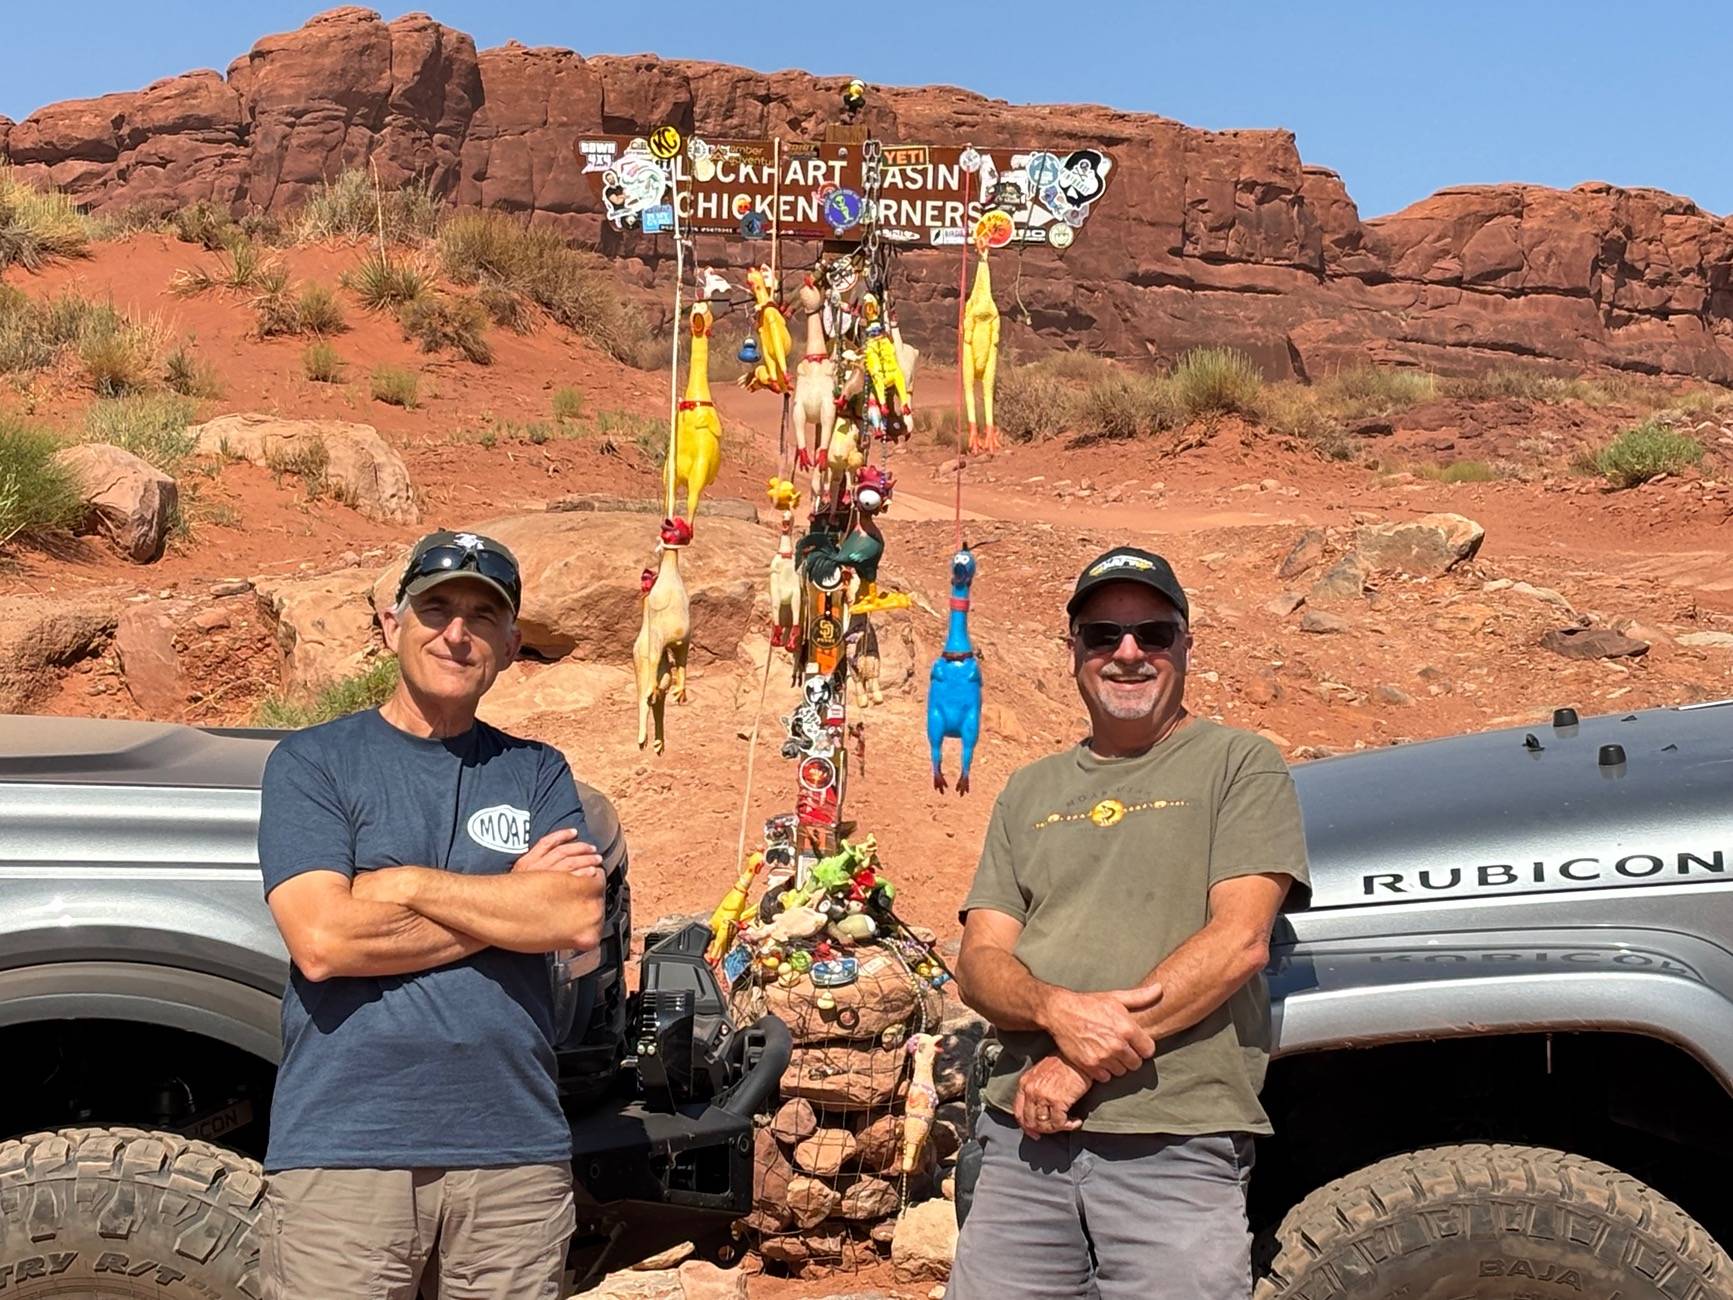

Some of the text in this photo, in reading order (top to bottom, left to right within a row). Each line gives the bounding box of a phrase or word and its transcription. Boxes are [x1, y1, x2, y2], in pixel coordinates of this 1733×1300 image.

[653, 127, 679, 156] KC
[676, 155, 848, 186] LCKHART
[884, 151, 924, 165] YETI
[1363, 850, 1725, 895] RUBICON
[1479, 1259, 1584, 1292] BAJA
